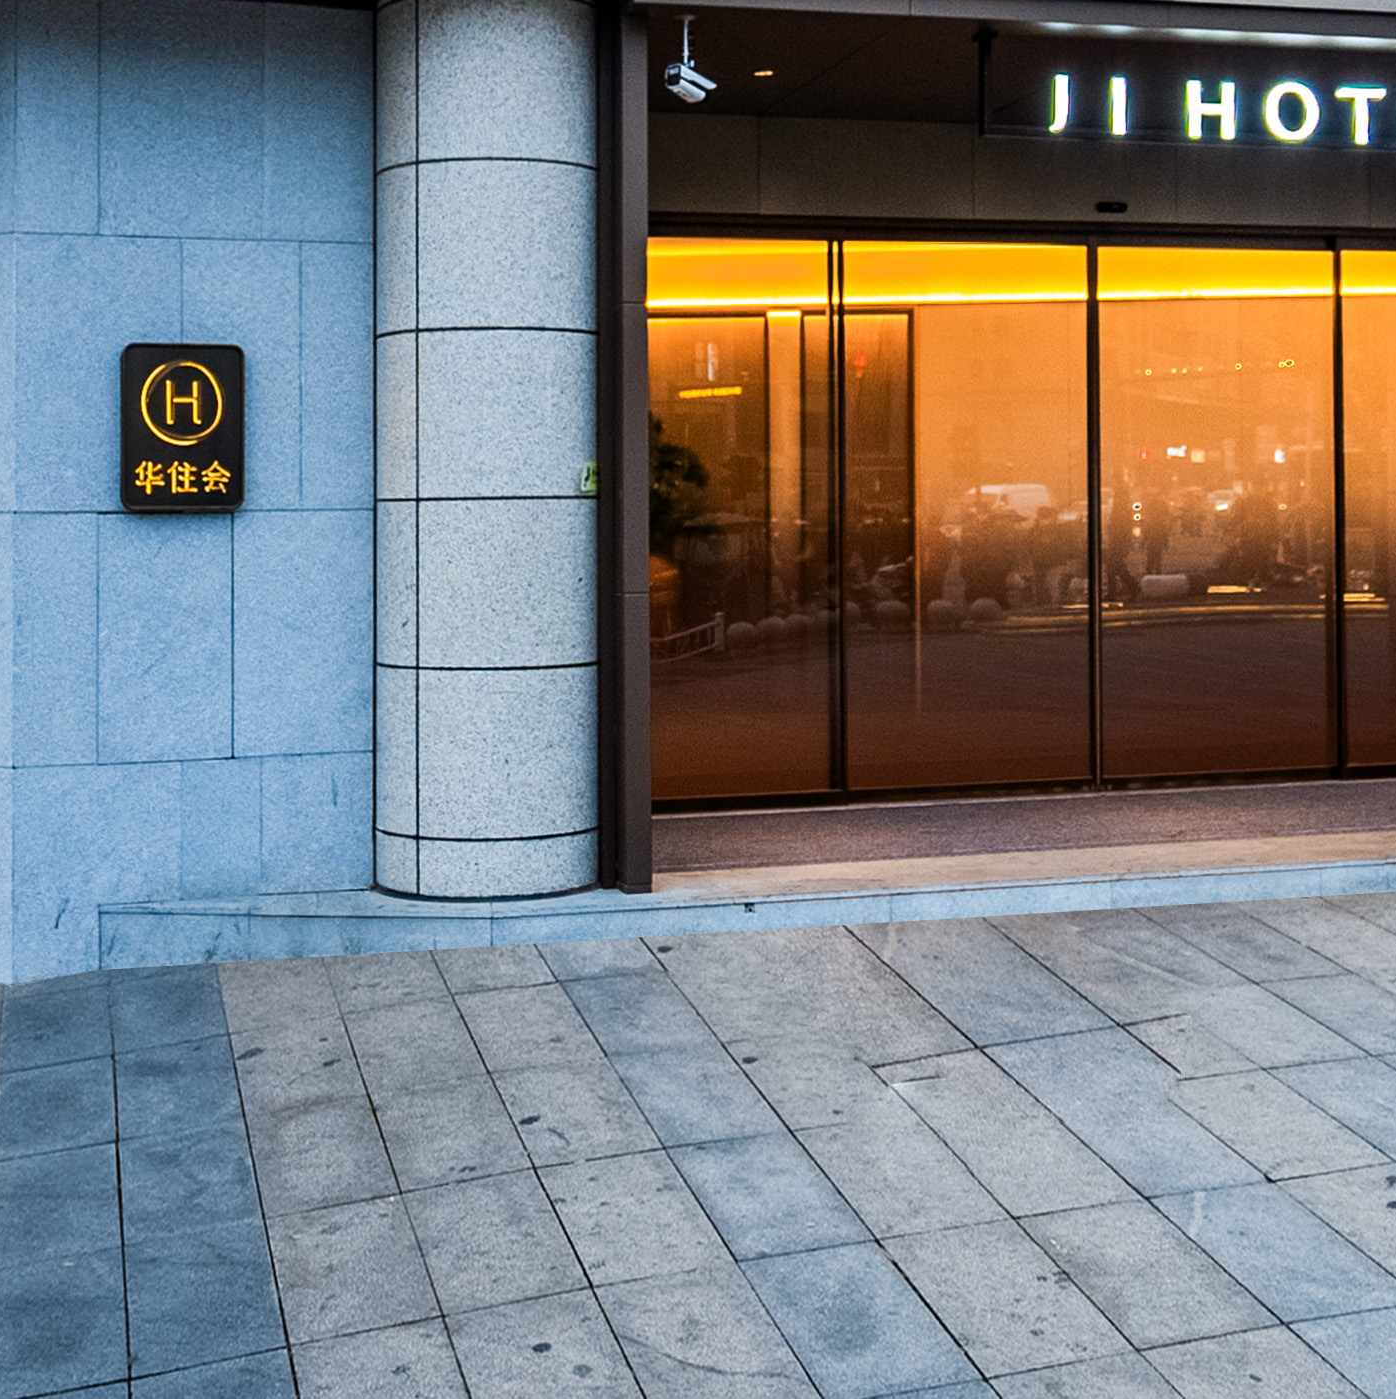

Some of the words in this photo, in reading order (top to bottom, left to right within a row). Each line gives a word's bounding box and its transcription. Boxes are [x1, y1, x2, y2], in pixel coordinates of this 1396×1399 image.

[1048, 72, 1129, 136] JI
[134, 459, 232, 496] 华住会
